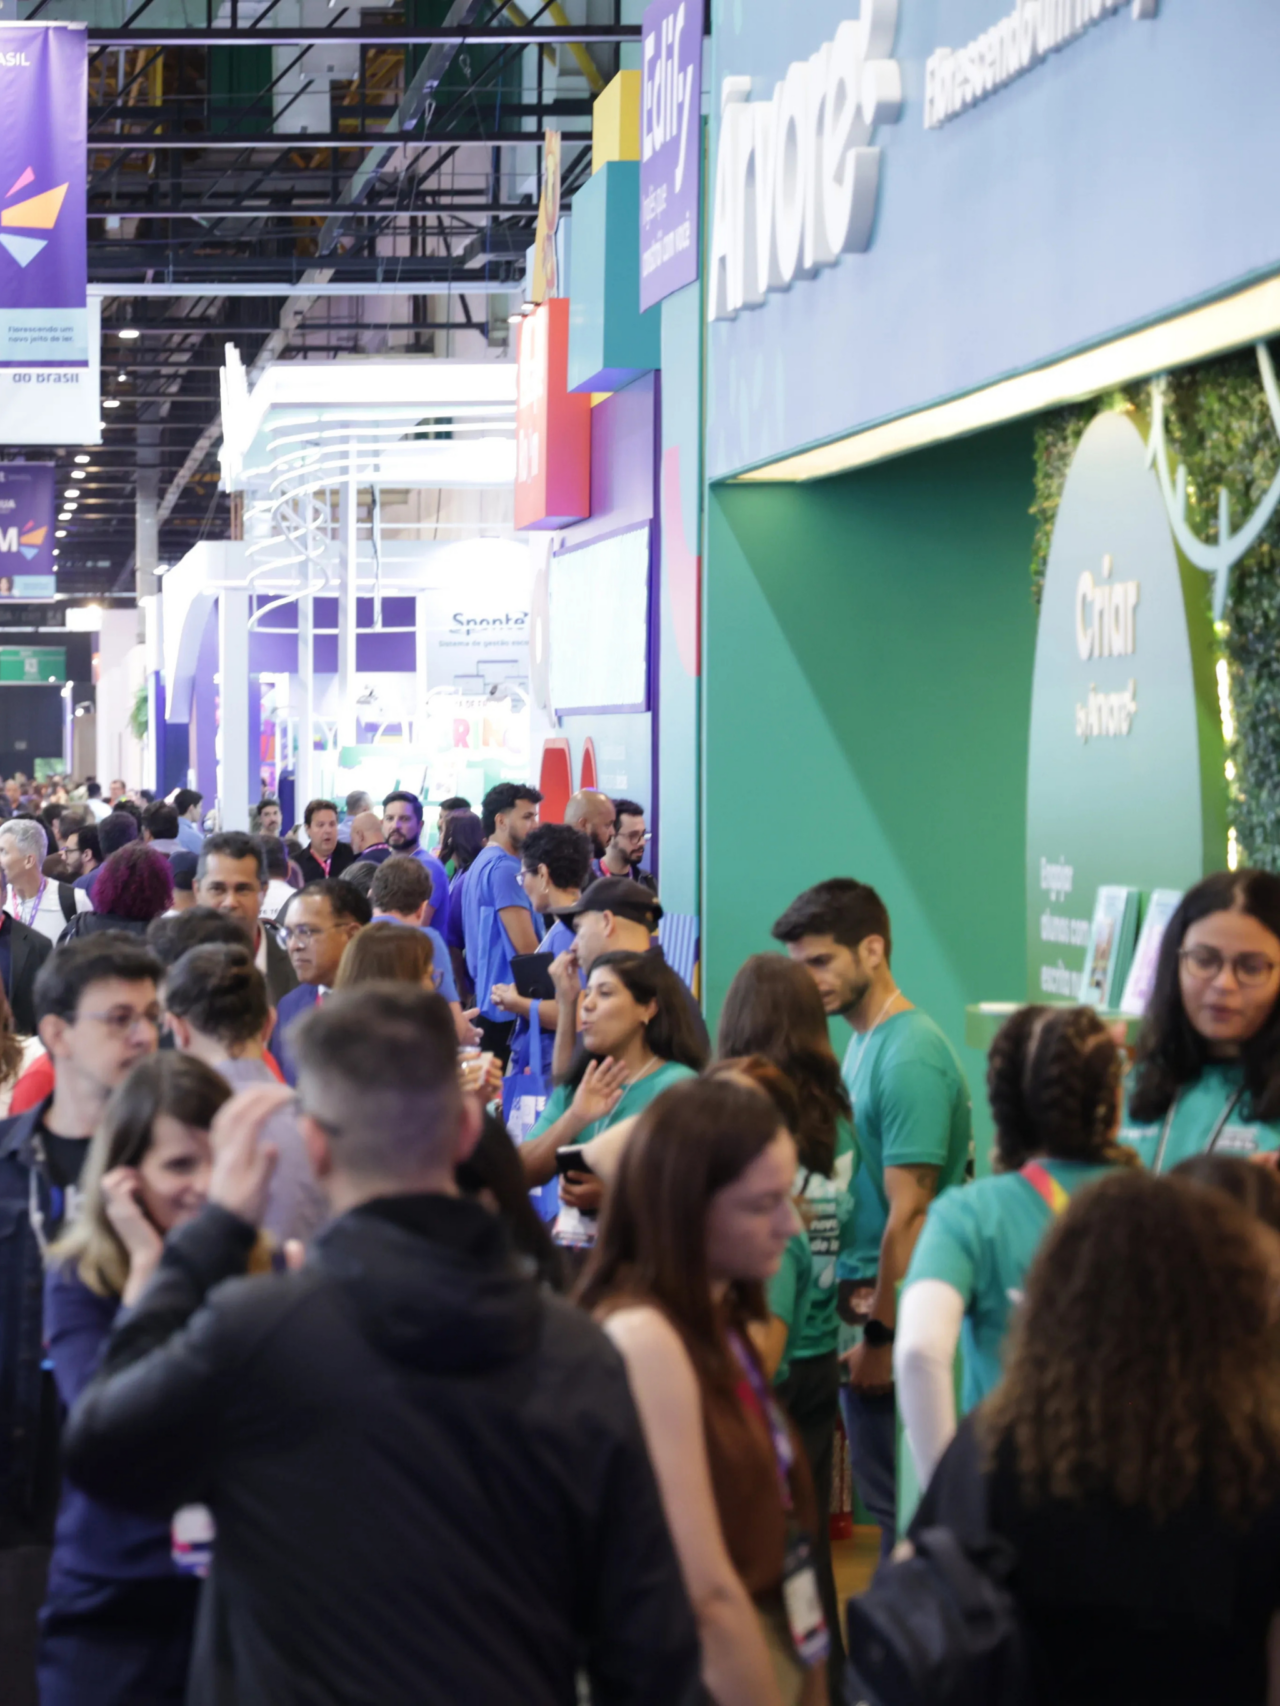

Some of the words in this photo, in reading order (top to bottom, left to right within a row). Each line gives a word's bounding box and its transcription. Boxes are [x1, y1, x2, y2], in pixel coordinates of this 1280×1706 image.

[642, 2, 694, 194] Edify
[8, 325, 60, 333] Florescendo
[29, 334, 48, 344] jeito
[50, 334, 60, 342] de
[1076, 553, 1140, 662] Criar
[451, 612, 528, 636] Sponte
[439, 639, 470, 648] Sistema
[472, 639, 481, 647] de
[484, 639, 510, 649] gestão
